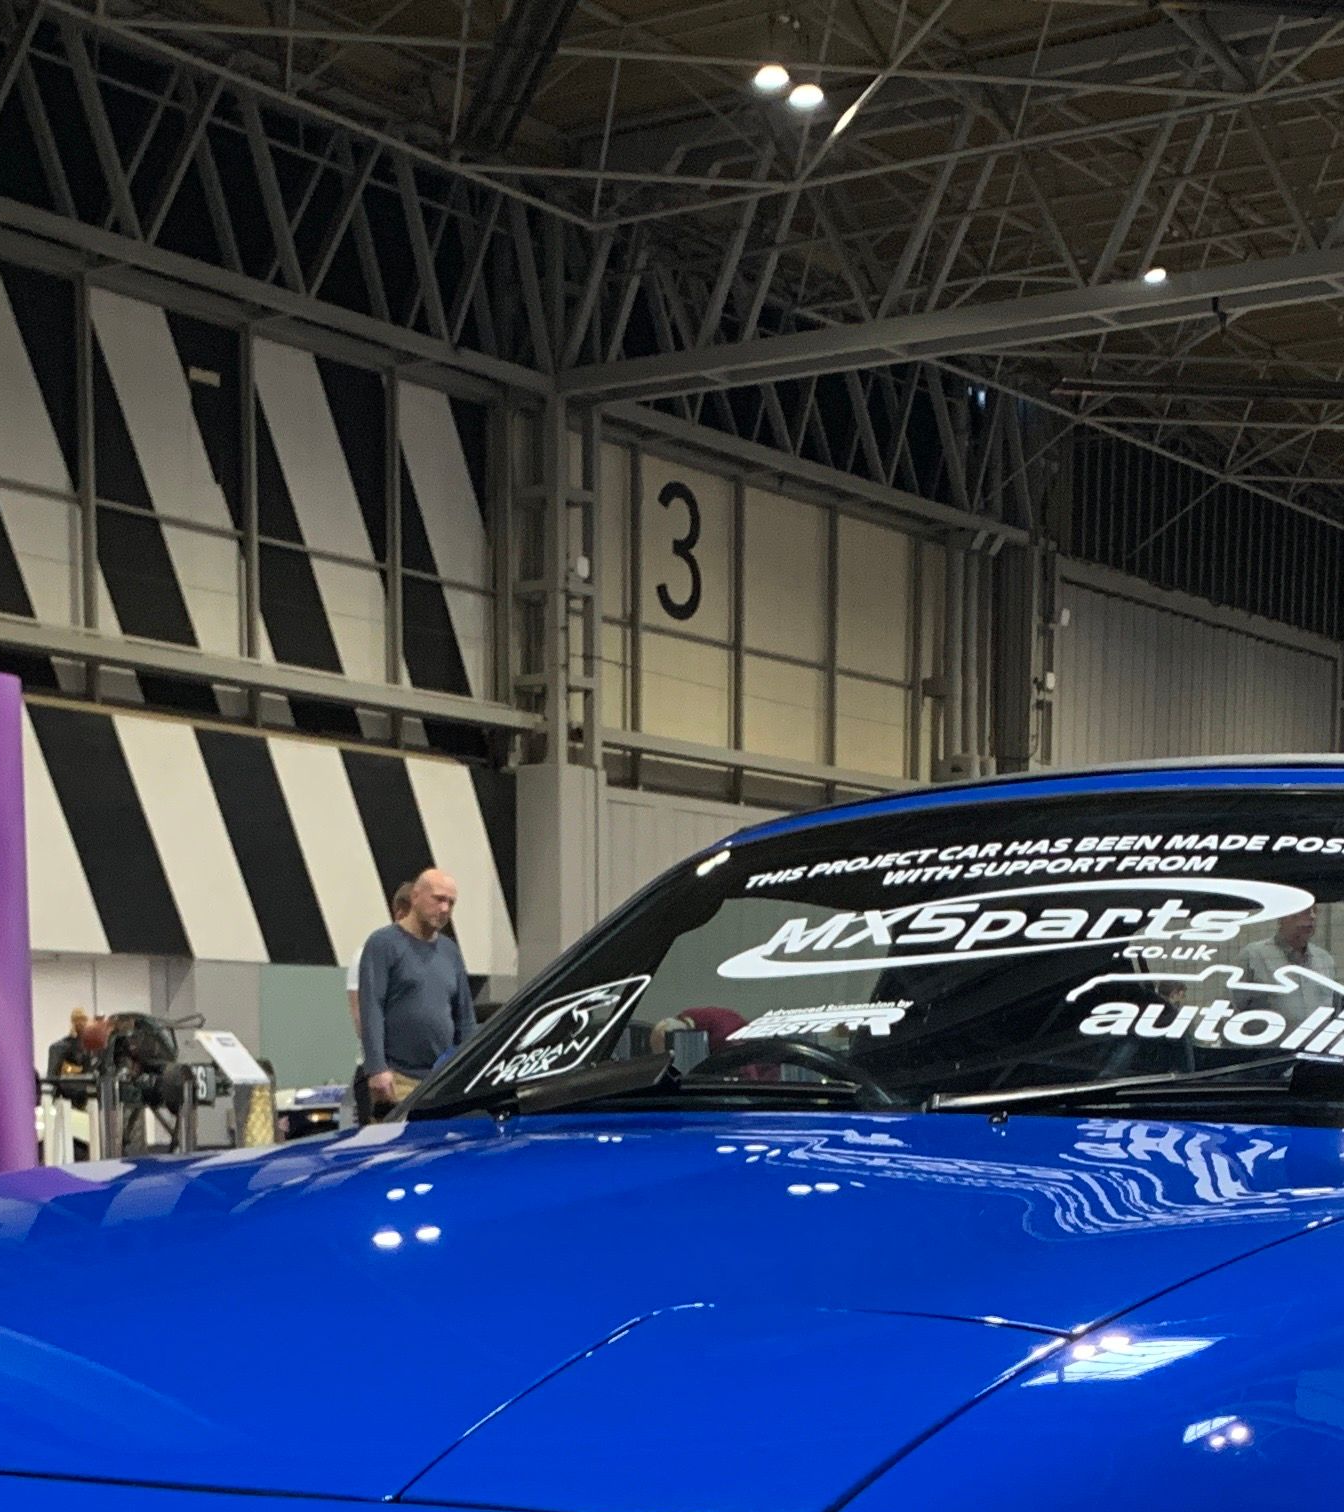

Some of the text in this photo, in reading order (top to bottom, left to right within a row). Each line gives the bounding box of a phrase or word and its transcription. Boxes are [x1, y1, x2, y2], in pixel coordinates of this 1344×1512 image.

[656, 481, 701, 620] 3
[745, 867, 807, 889] THIS
[807, 849, 938, 878] PROJECT
[938, 842, 1002, 862] CAR
[1003, 837, 1073, 855] HAS
[1074, 835, 1162, 853] BEEN
[1163, 834, 1267, 852] MADE
[882, 856, 1218, 887] WITH SUPPORT FROM
[760, 899, 1253, 956] MX5parts
[1112, 944, 1218, 962] .co.uk
[484, 1036, 590, 1078] ADRIAN
[491, 1055, 559, 1087] FLUX
